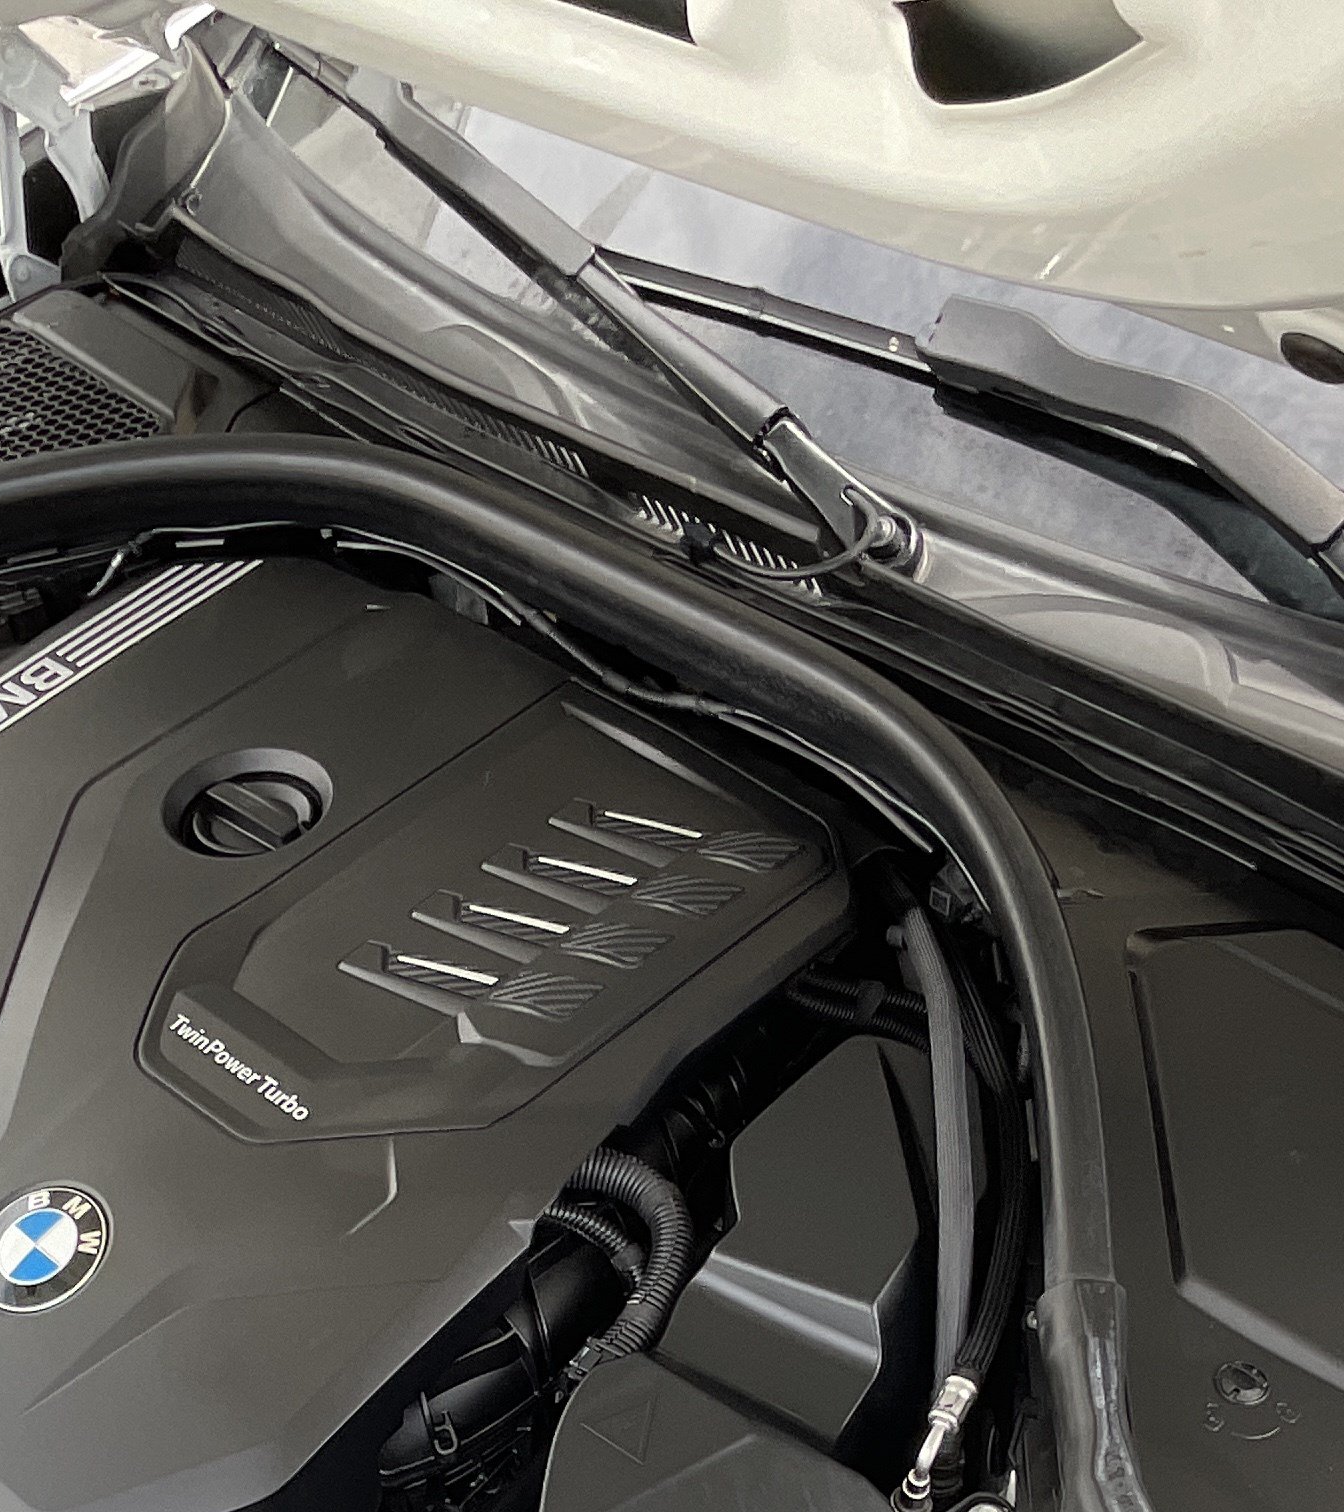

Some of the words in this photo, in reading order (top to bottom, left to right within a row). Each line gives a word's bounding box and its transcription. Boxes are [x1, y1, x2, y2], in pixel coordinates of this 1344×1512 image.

[169, 1014, 261, 1084] TwinPower
[257, 1075, 309, 1121] Turbo
[27, 1191, 102, 1255] BMW
